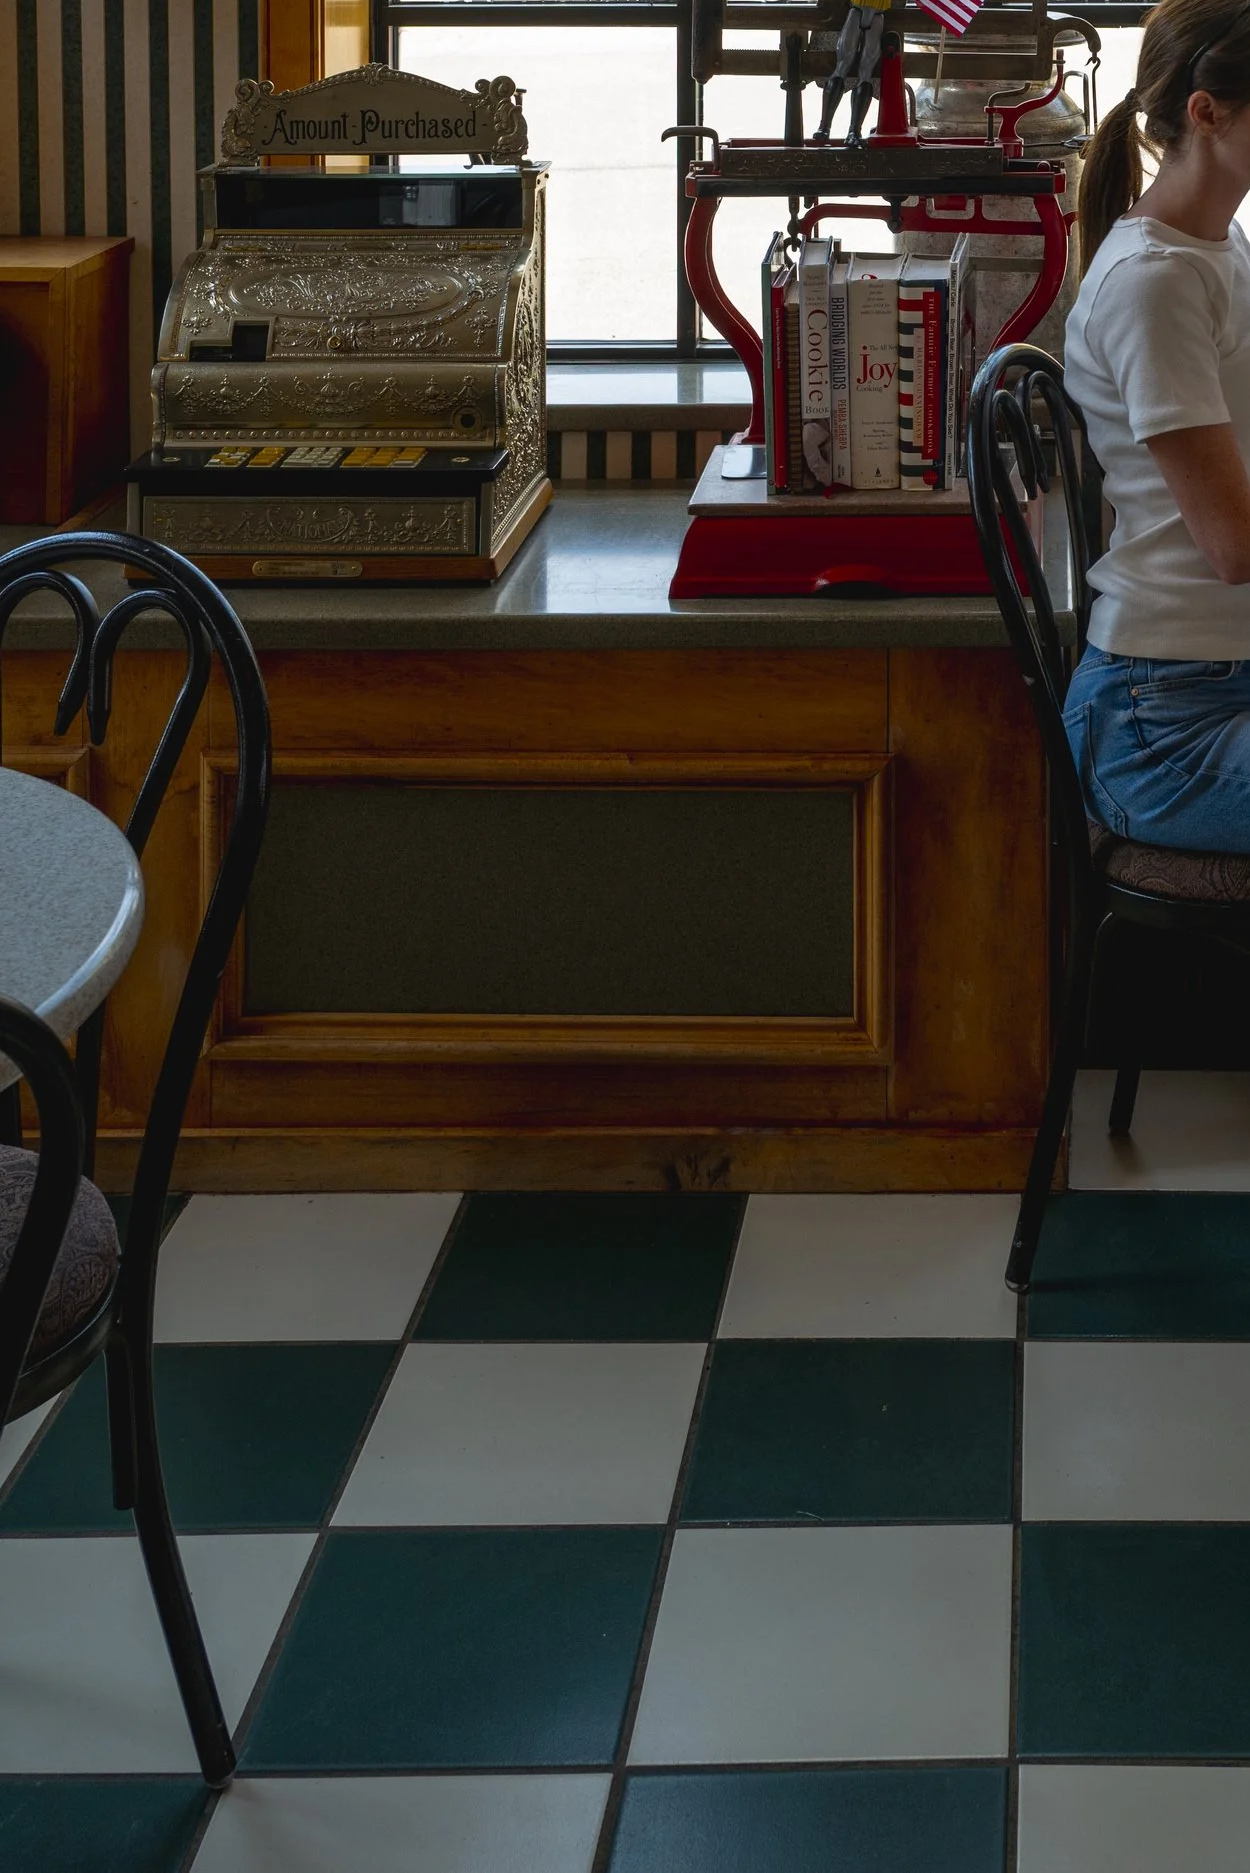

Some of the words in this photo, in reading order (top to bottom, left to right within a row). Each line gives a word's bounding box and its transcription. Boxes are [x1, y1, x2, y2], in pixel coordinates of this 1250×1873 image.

[262, 109, 350, 146] Amount
[352, 109, 476, 146] Purchased
[831, 297, 846, 345] BRIDGING
[928, 320, 937, 356] Fannie
[807, 309, 828, 402] Cookie
[832, 348, 847, 390] WORLDS
[927, 360, 937, 398] Farmer
[837, 399, 847, 423] PEMBA
[837, 424, 848, 450] SHERPA
